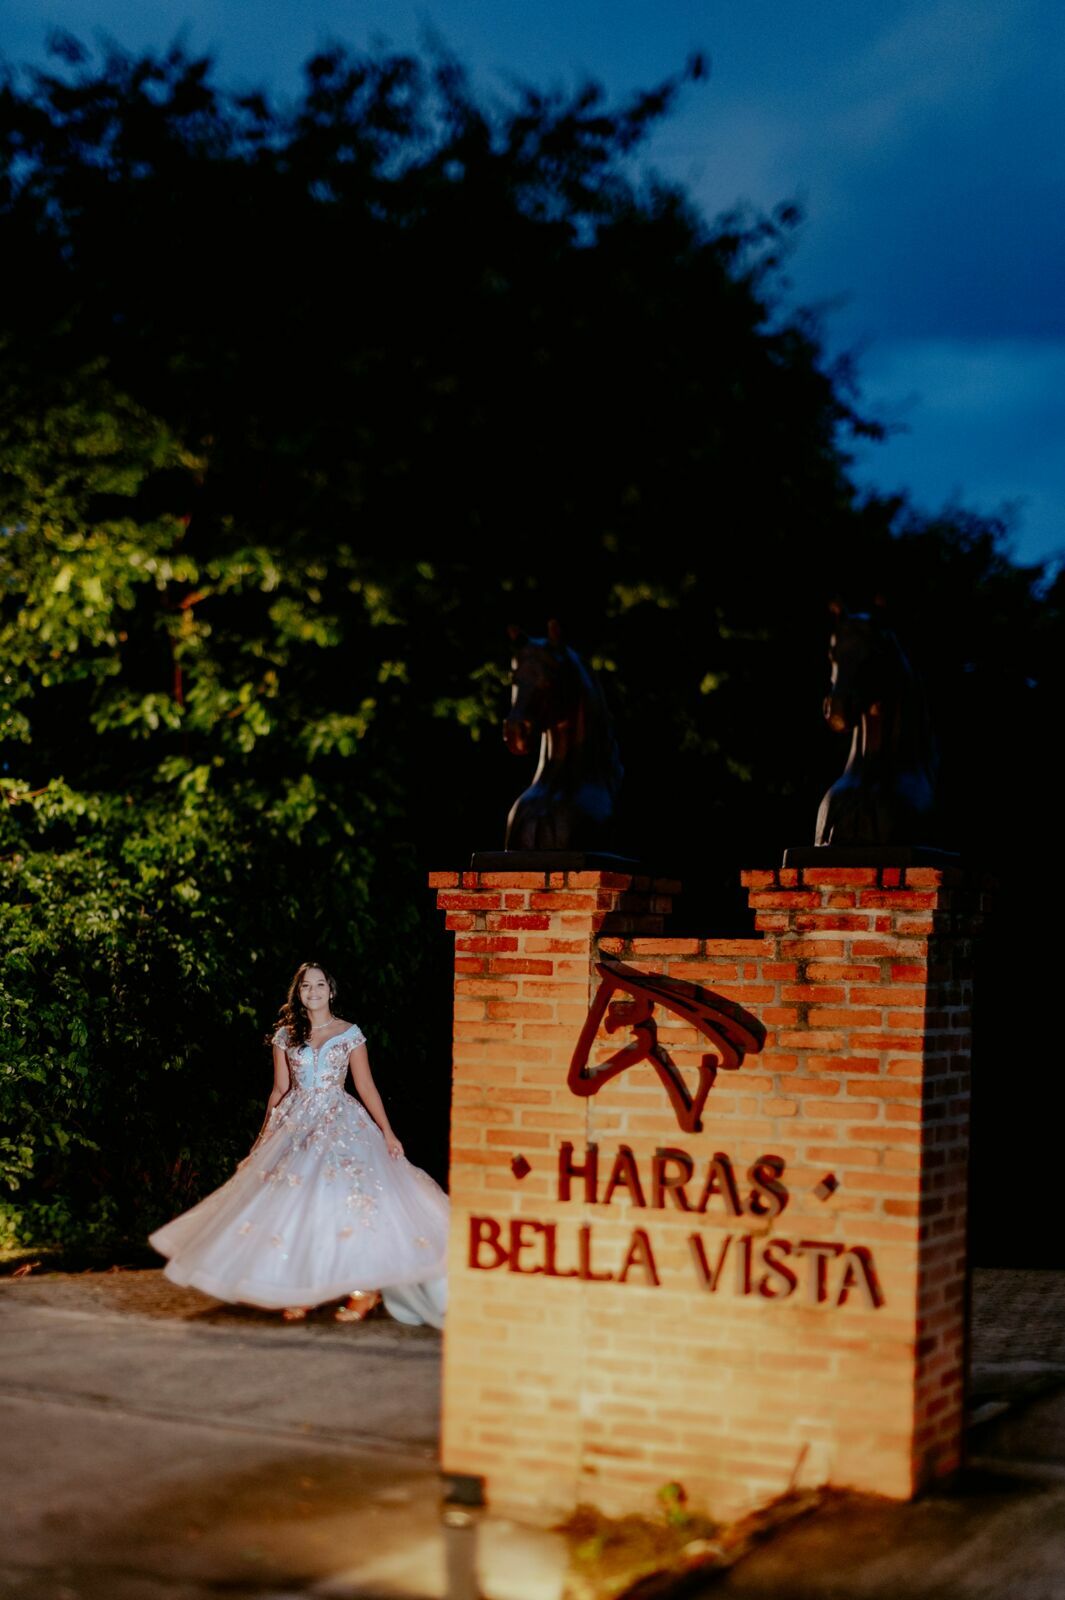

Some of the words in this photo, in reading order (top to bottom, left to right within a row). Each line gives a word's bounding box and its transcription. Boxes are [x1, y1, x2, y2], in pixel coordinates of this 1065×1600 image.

[557, 1141, 789, 1219] HARAS
[467, 1213, 661, 1287] BELLA
[688, 1233, 886, 1309] VISTA
